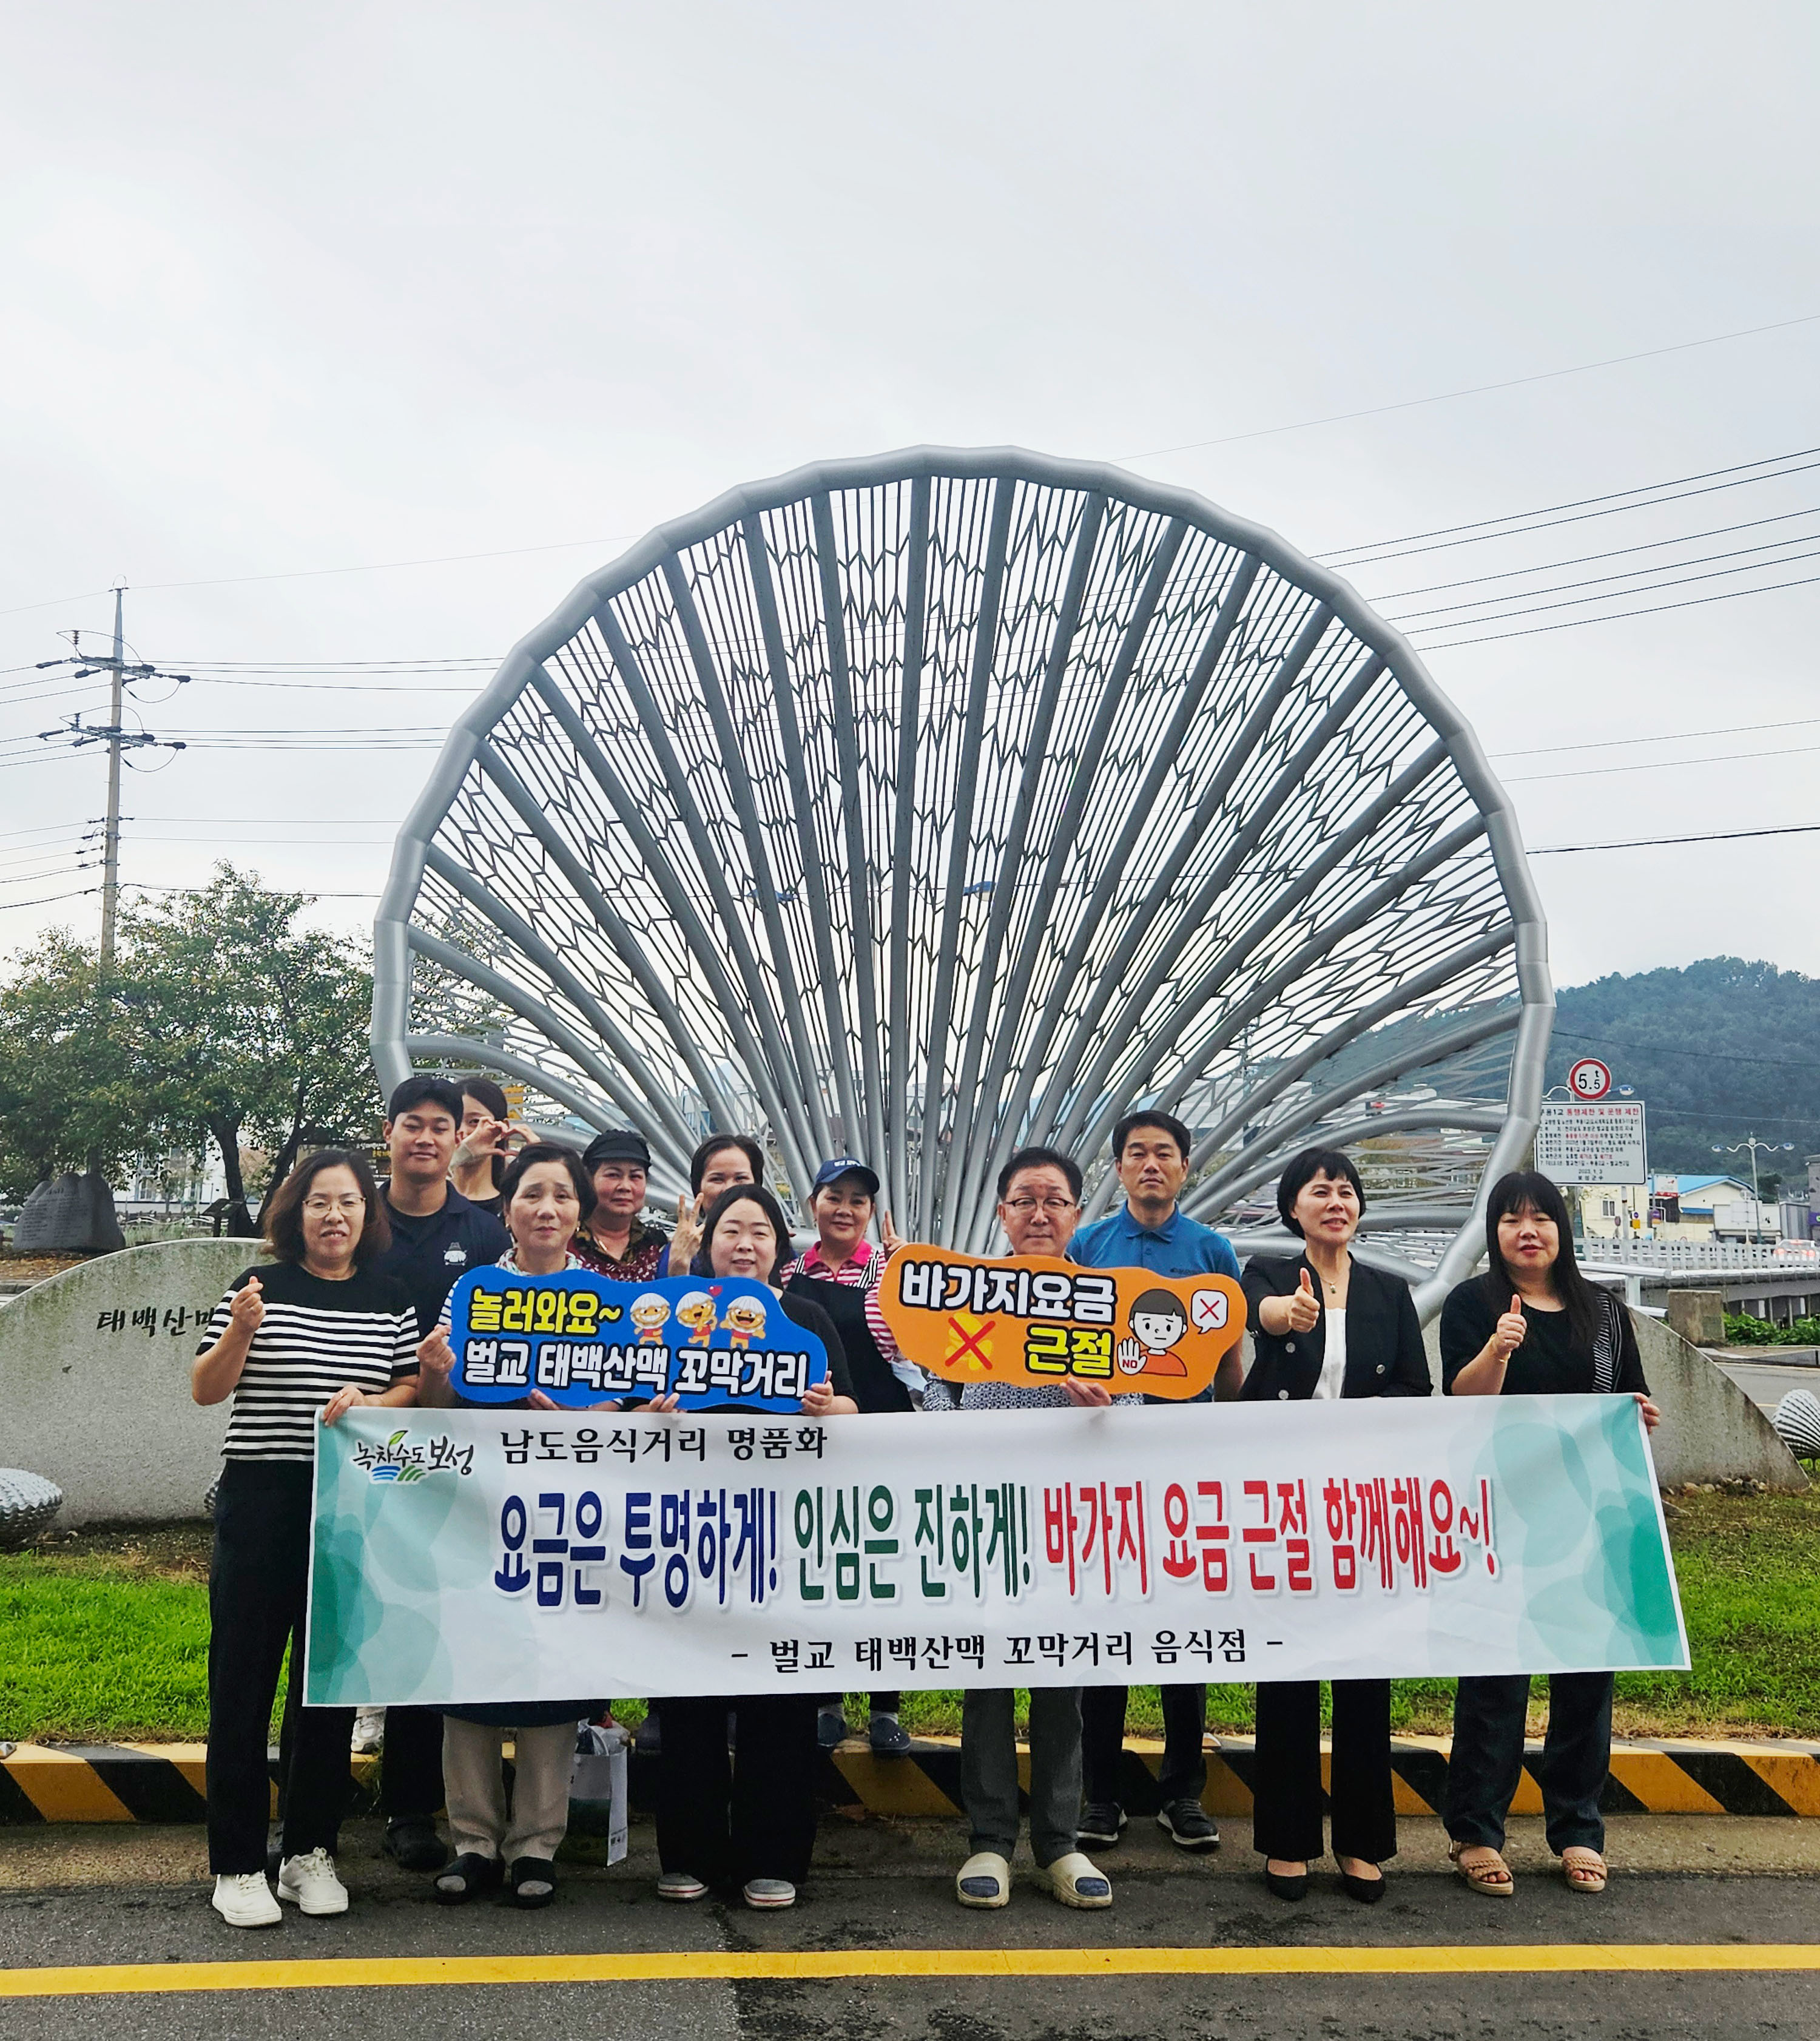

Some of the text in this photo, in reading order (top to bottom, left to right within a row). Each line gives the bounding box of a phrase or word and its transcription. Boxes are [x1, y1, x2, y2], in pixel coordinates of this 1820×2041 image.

[1579, 1073, 1600, 1090] 5.5
[1566, 1108, 1595, 1116] 통행제한
[1625, 1107, 1639, 1116] 제한
[471, 1288, 621, 1334] 놀러와요~
[902, 1263, 1114, 1323] 바가지요금
[465, 1340, 807, 1397] 벌교 태백산맥 꼬막거리
[1027, 1326, 1111, 1377] 근절
[1122, 1359, 1138, 1369] NO
[352, 1435, 474, 1476] 녹차수도 보성
[500, 1426, 827, 1464] 남도음식거리 명품화
[494, 1477, 1495, 1608] 요금은 투명하게! 인심은 진하게! 바가지 요금 근절 함께해요~!
[770, 1639, 835, 1673] 벌교
[854, 1634, 985, 1672] 태백산맥
[1003, 1631, 1132, 1667] 꼬막거리
[1151, 1628, 1245, 1664] 음식점
